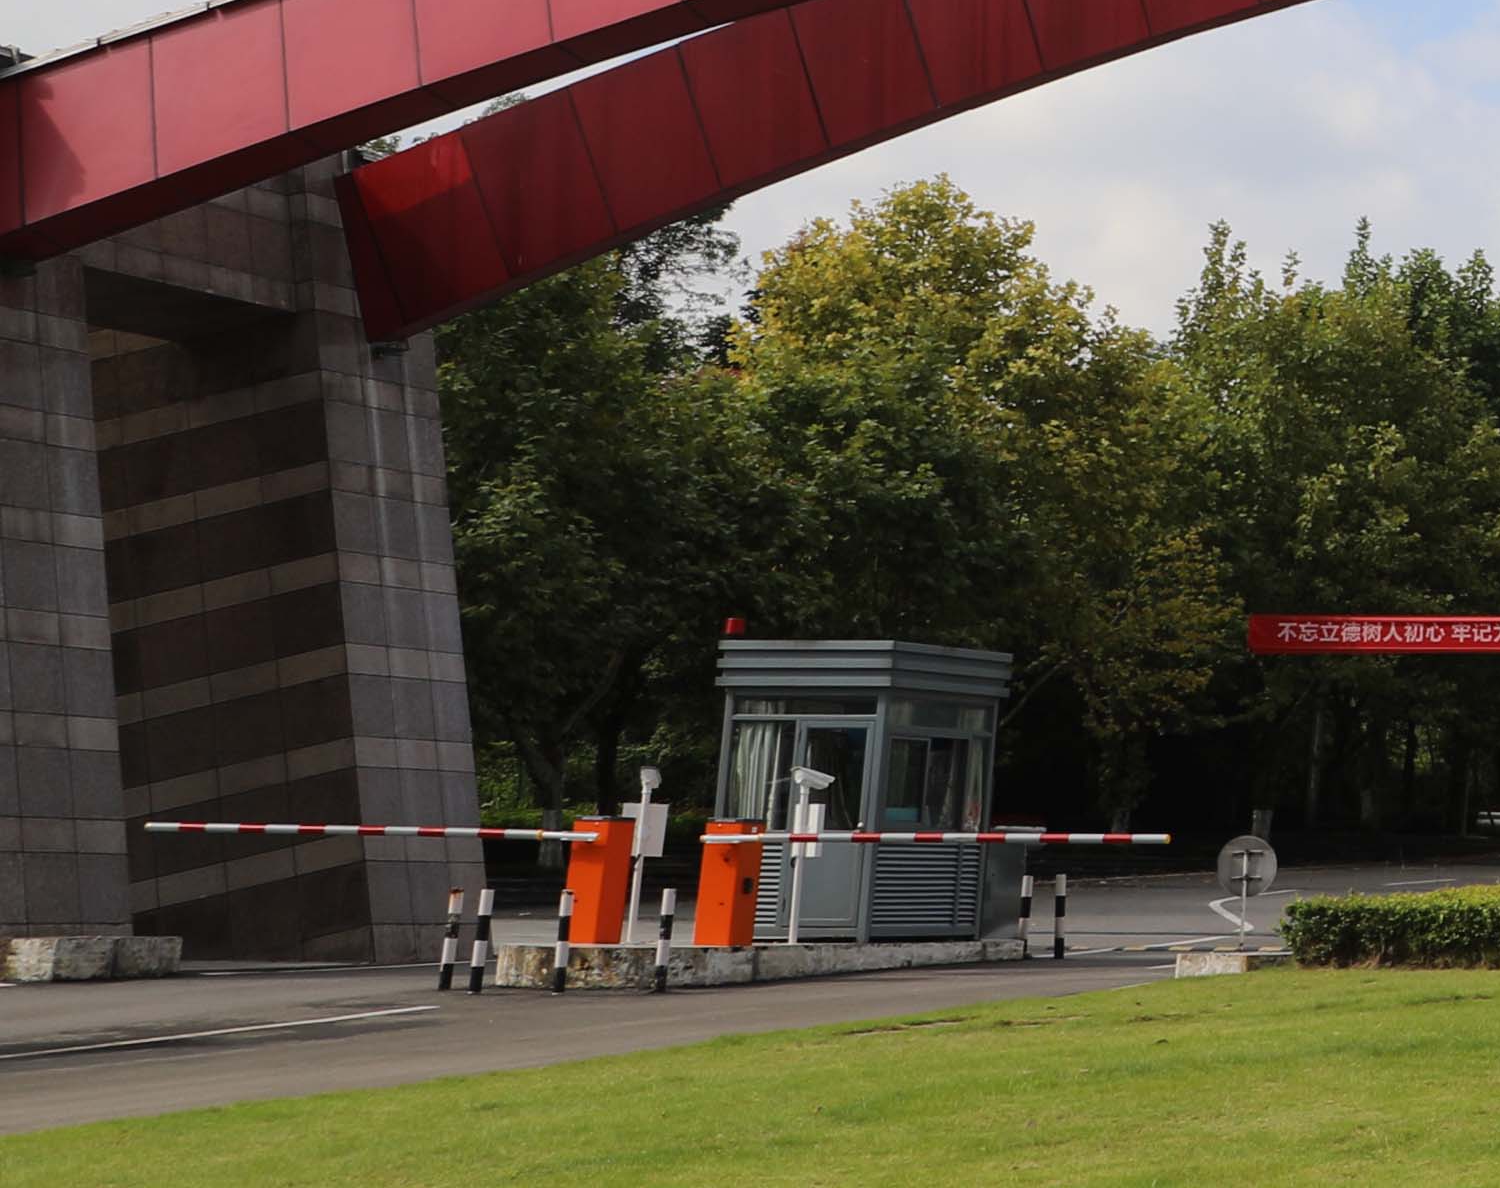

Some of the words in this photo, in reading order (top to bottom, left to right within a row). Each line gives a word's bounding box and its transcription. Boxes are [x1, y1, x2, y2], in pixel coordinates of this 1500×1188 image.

[1277, 622, 1446, 643] 不忘立德树人初心
